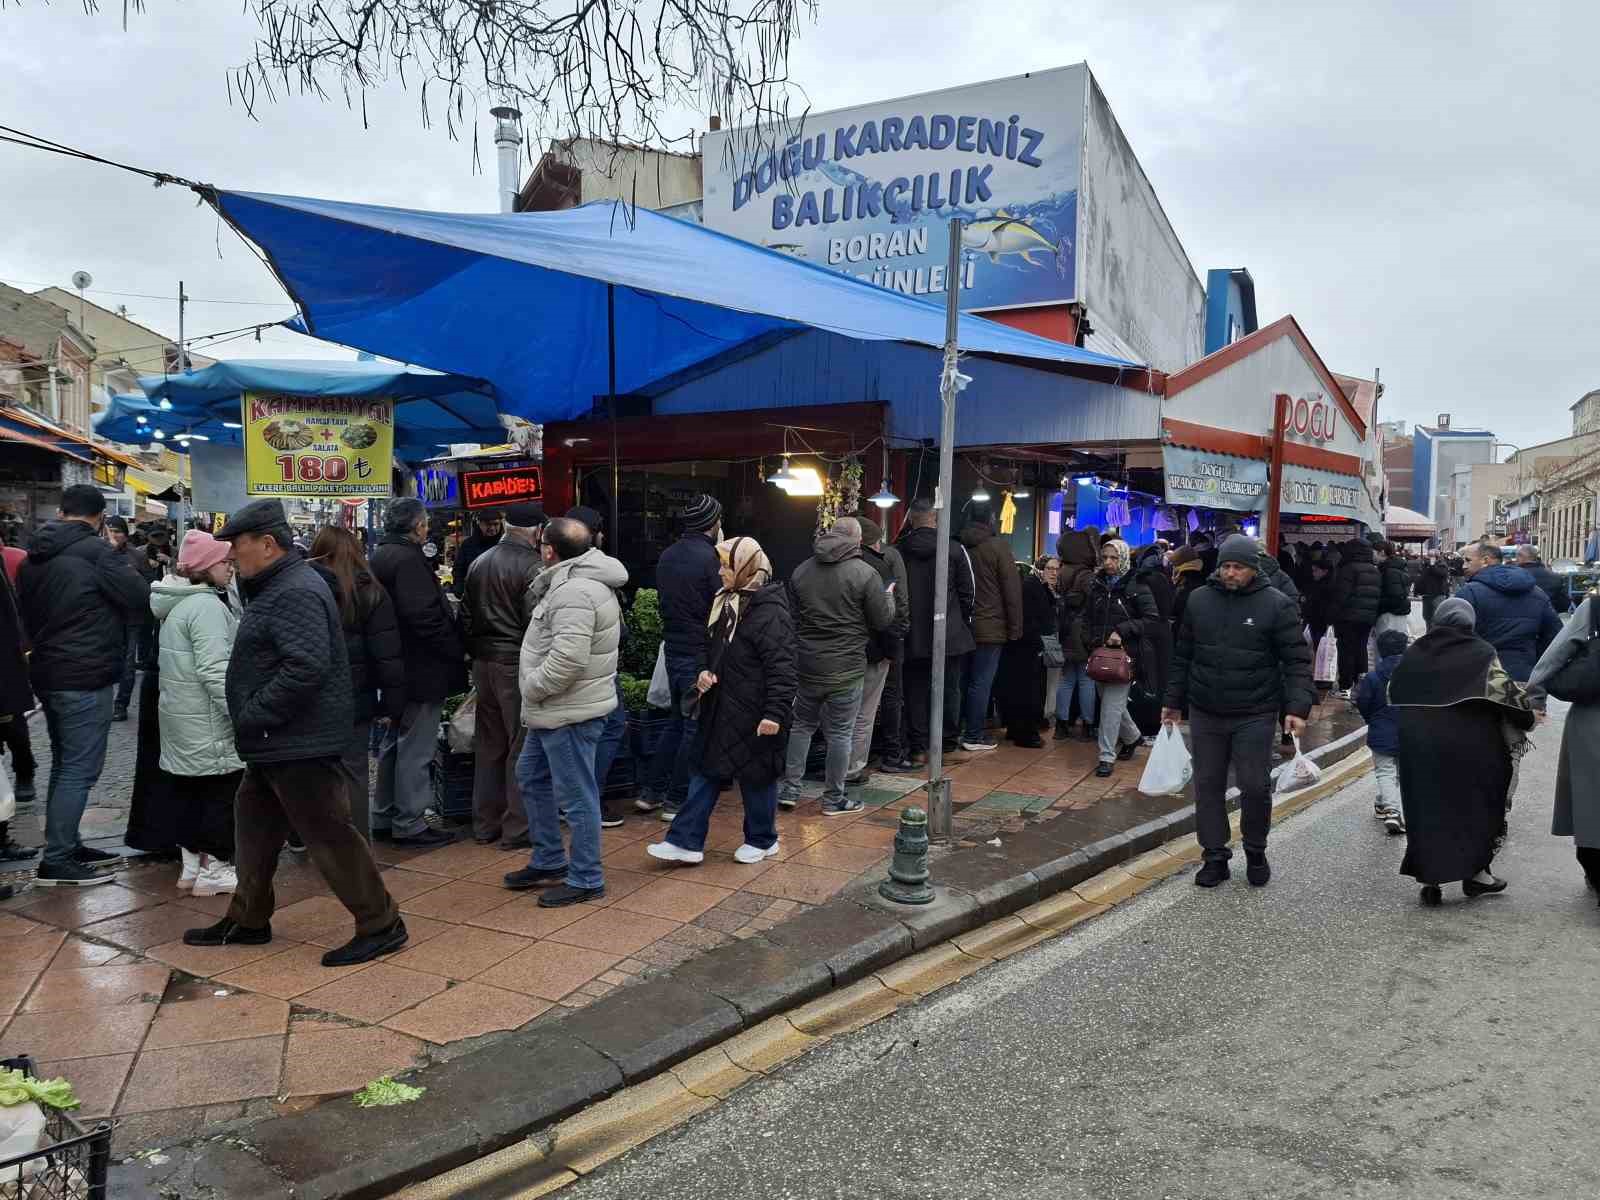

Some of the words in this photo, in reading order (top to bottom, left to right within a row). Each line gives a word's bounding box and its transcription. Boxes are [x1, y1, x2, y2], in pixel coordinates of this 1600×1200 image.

[732, 133, 826, 212] DOĞU
[833, 114, 1044, 168] KARADENİZ
[771, 163, 993, 230] BALIKÇILIK
[827, 226, 928, 266] BORAN
[276, 455, 349, 482] 180
